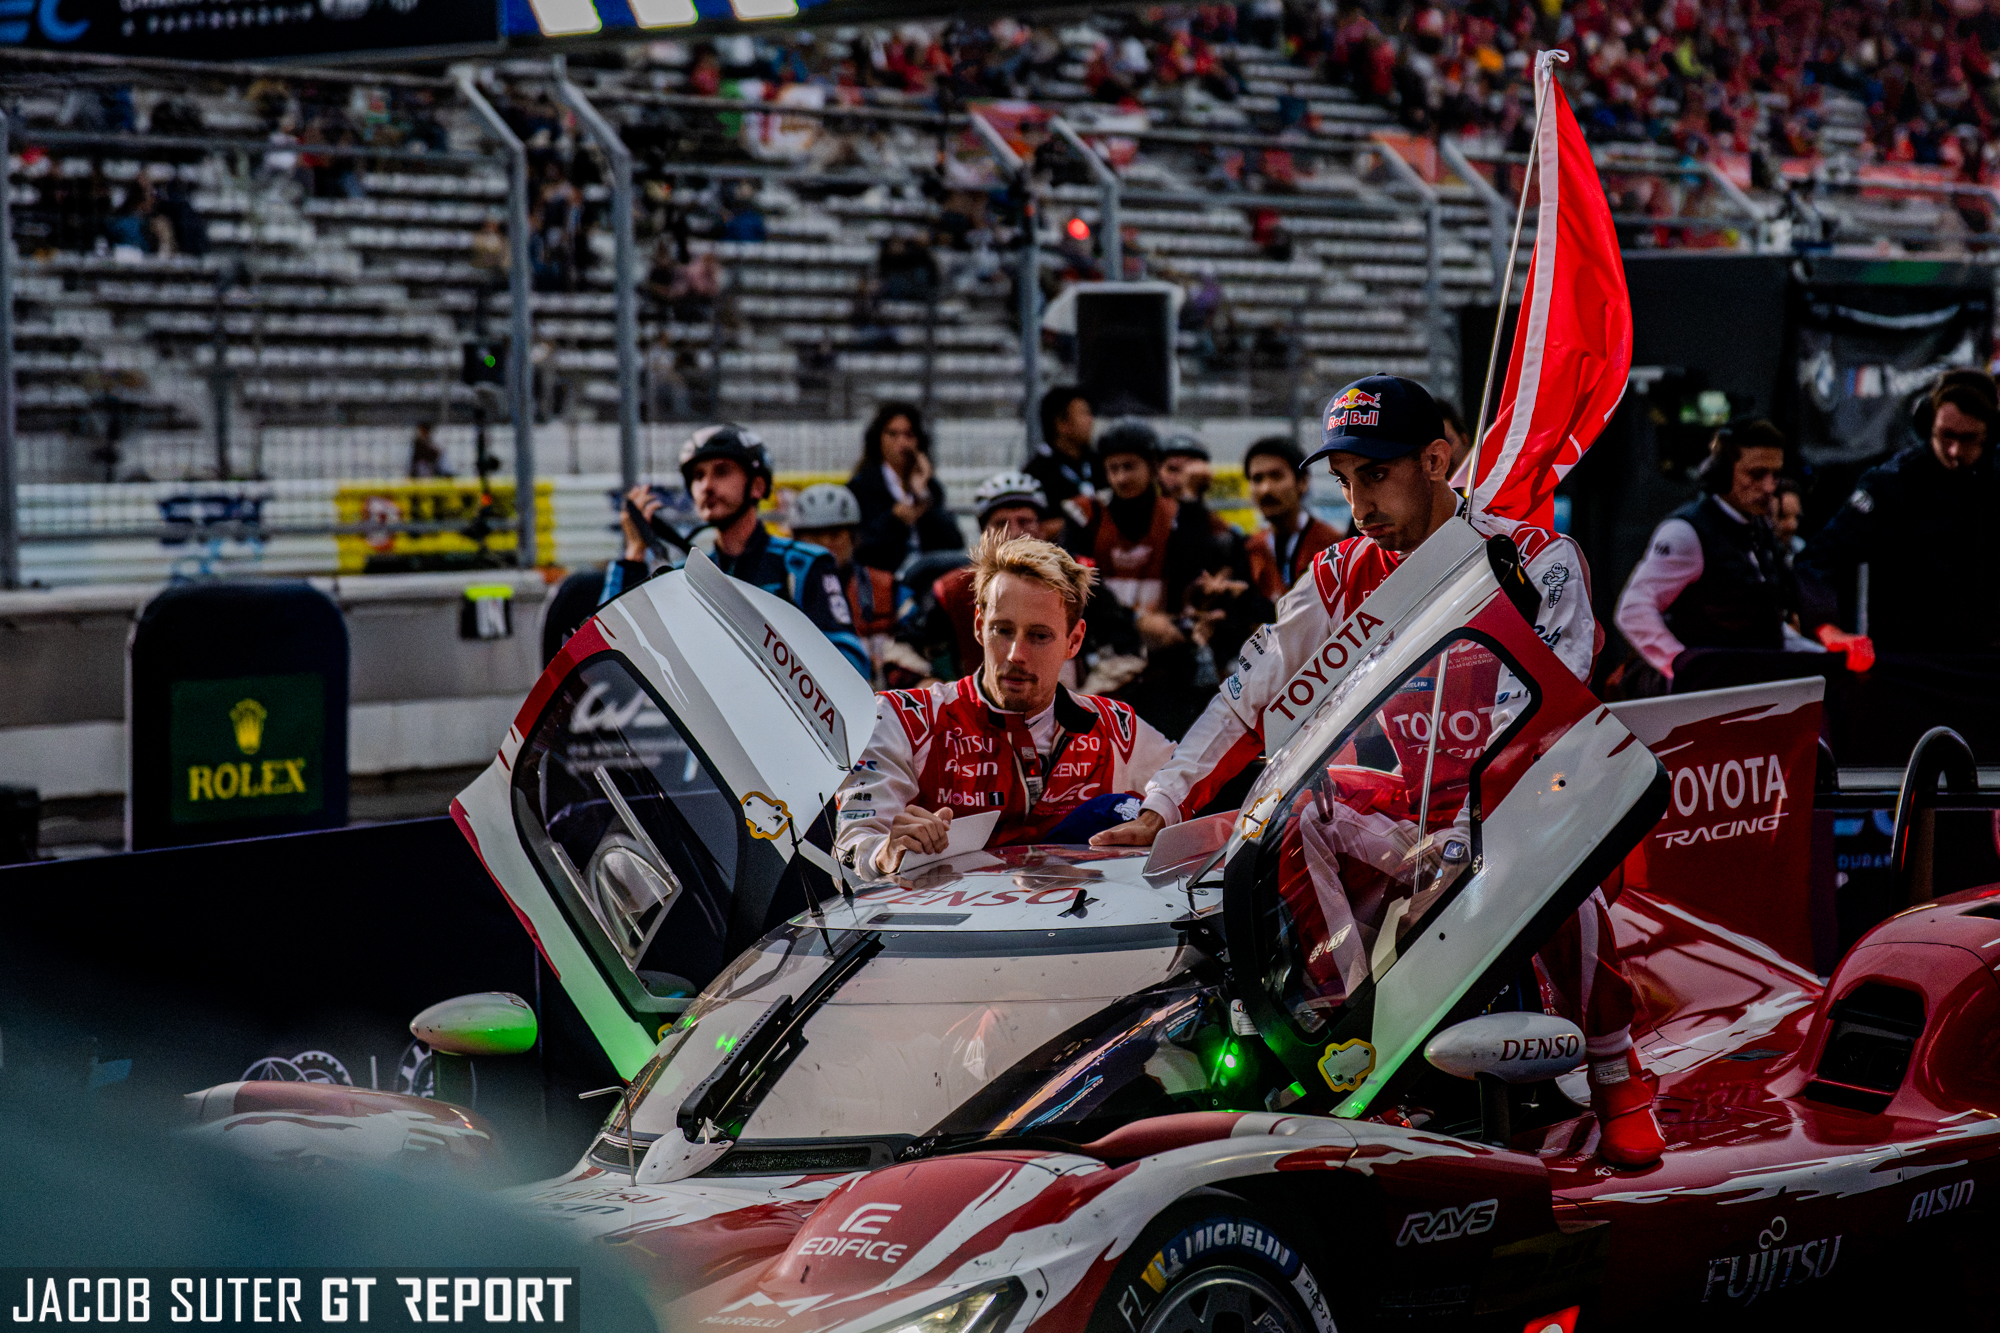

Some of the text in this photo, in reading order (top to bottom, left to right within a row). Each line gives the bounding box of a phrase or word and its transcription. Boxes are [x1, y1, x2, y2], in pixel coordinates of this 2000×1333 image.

[1328, 410, 1380, 431] Red Bull
[763, 623, 835, 734] TOYOTA
[1269, 611, 1385, 721] TOYOTA
[1393, 706, 1494, 742] TOYOT
[188, 758, 307, 801] ROLEX
[937, 787, 986, 807] Mobil
[1655, 812, 1790, 850] RACING
[1500, 1035, 1580, 1062] DENSO
[1906, 1179, 1975, 1223] AISIN
[1396, 1198, 1499, 1248] RAYS
[797, 1236, 909, 1264] EDIFICE
[1184, 1222, 1291, 1267] MICHELIN
[1701, 1234, 1843, 1308] FUJITSU
[699, 1315, 787, 1329] MARELLI
